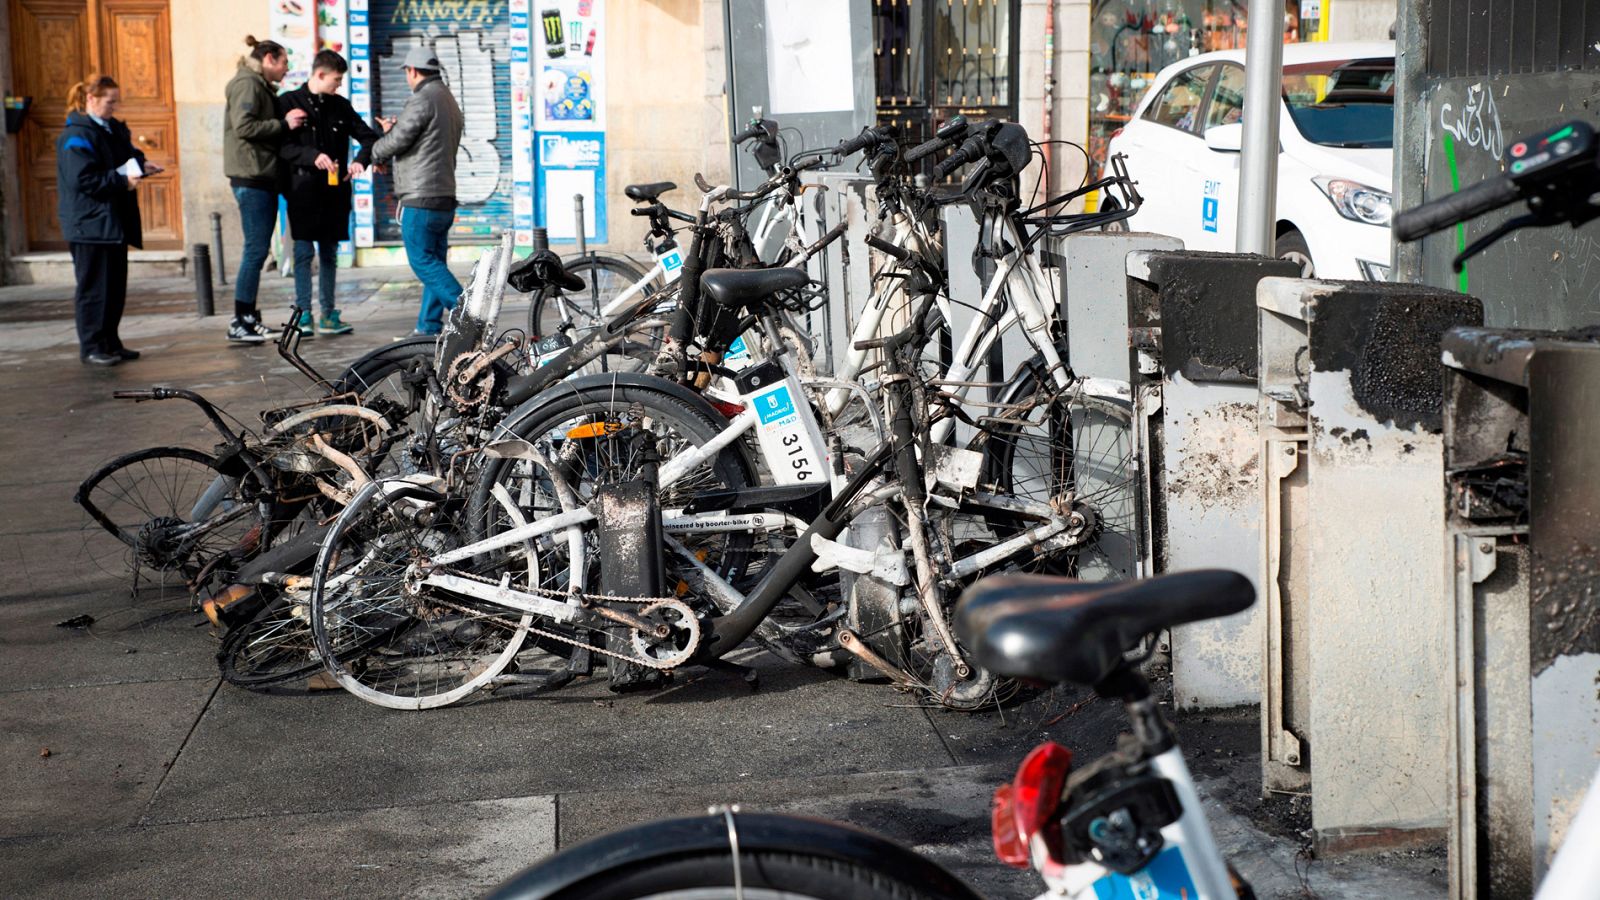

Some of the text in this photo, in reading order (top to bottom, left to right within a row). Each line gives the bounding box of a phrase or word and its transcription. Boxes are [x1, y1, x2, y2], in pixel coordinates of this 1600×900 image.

[1204, 180, 1221, 195] EMT
[782, 433, 812, 481] 3156
[695, 521, 704, 529] by
[705, 519, 750, 527] booster-bikes
